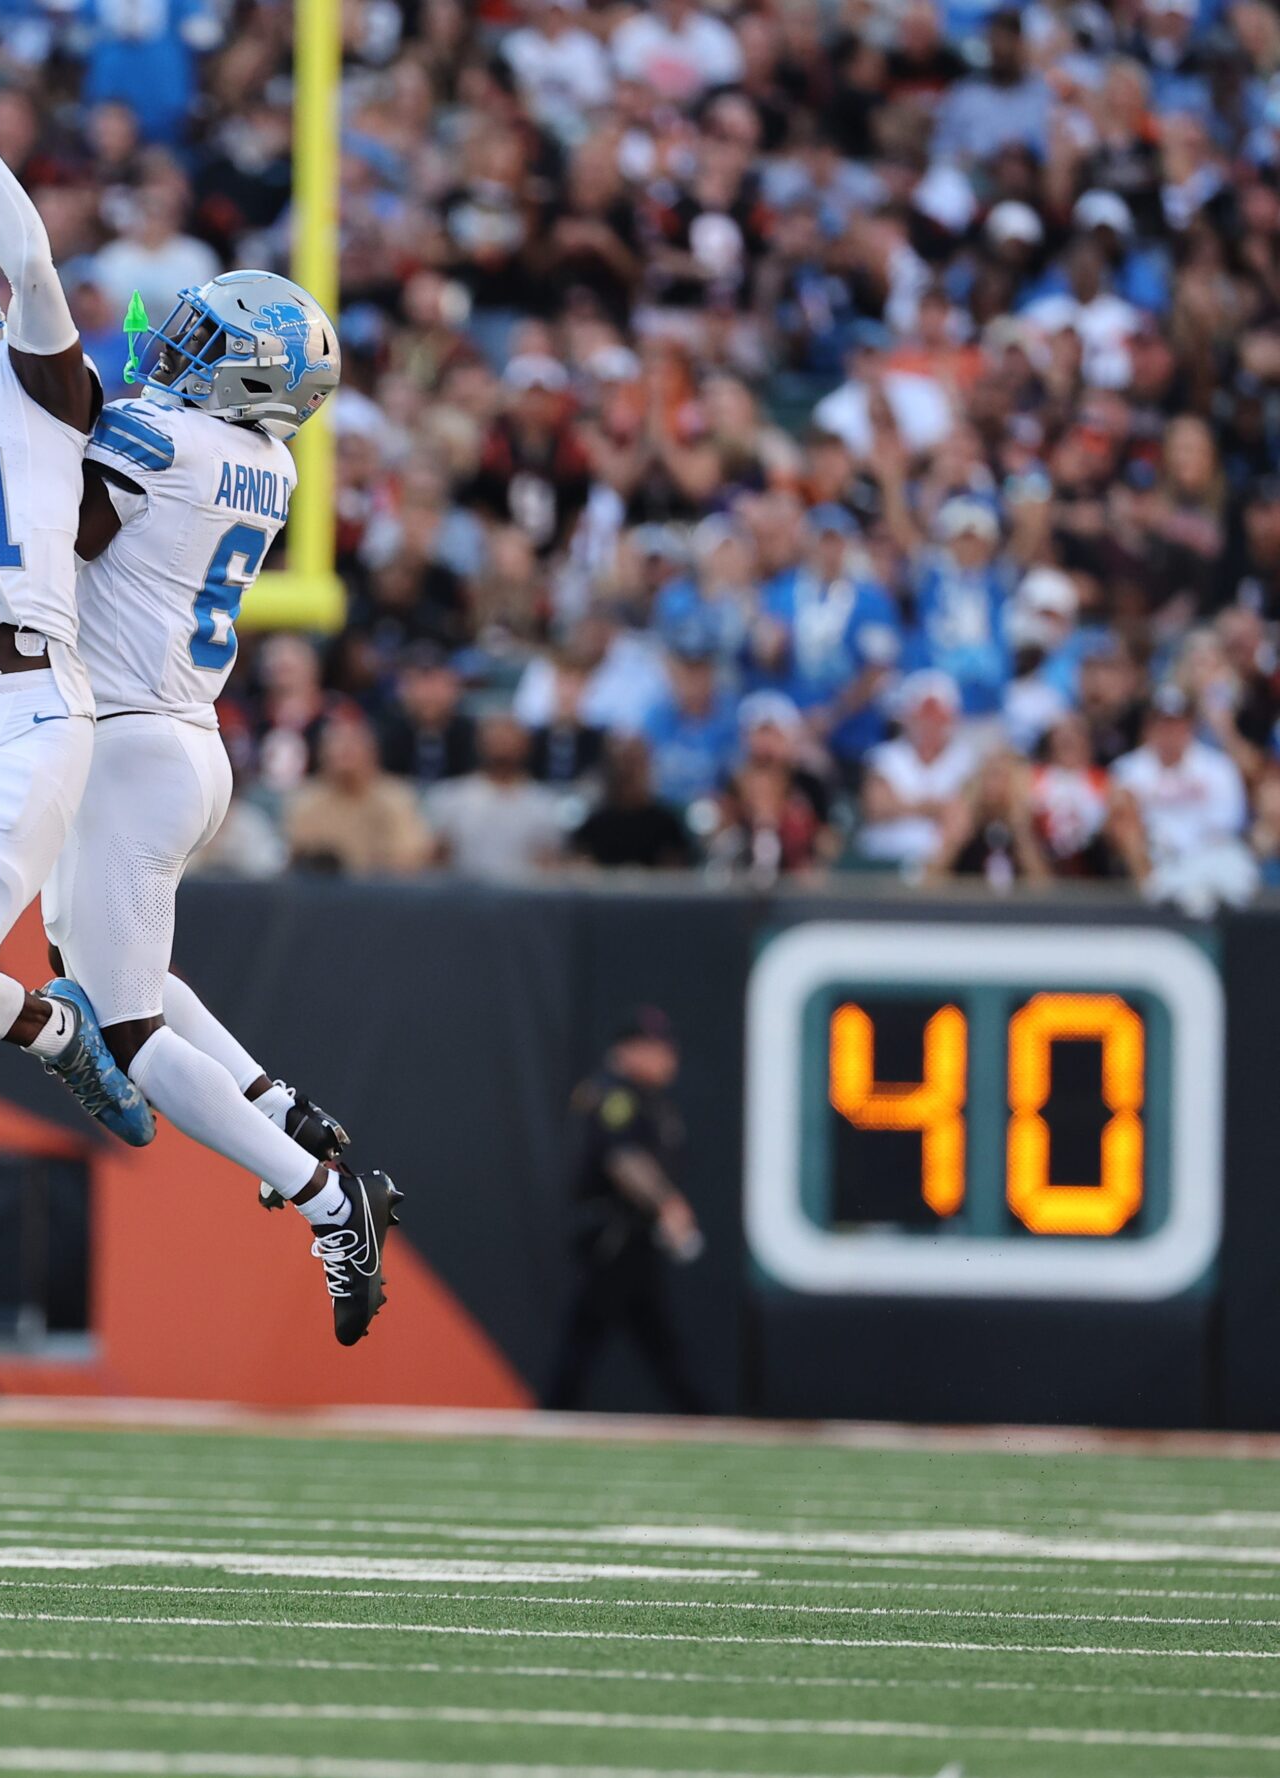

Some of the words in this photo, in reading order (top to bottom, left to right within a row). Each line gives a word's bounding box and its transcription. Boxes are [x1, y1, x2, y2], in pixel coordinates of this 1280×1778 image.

[214, 460, 289, 522] ARNOLD
[187, 521, 267, 673] 6
[829, 992, 1145, 1236] 40
